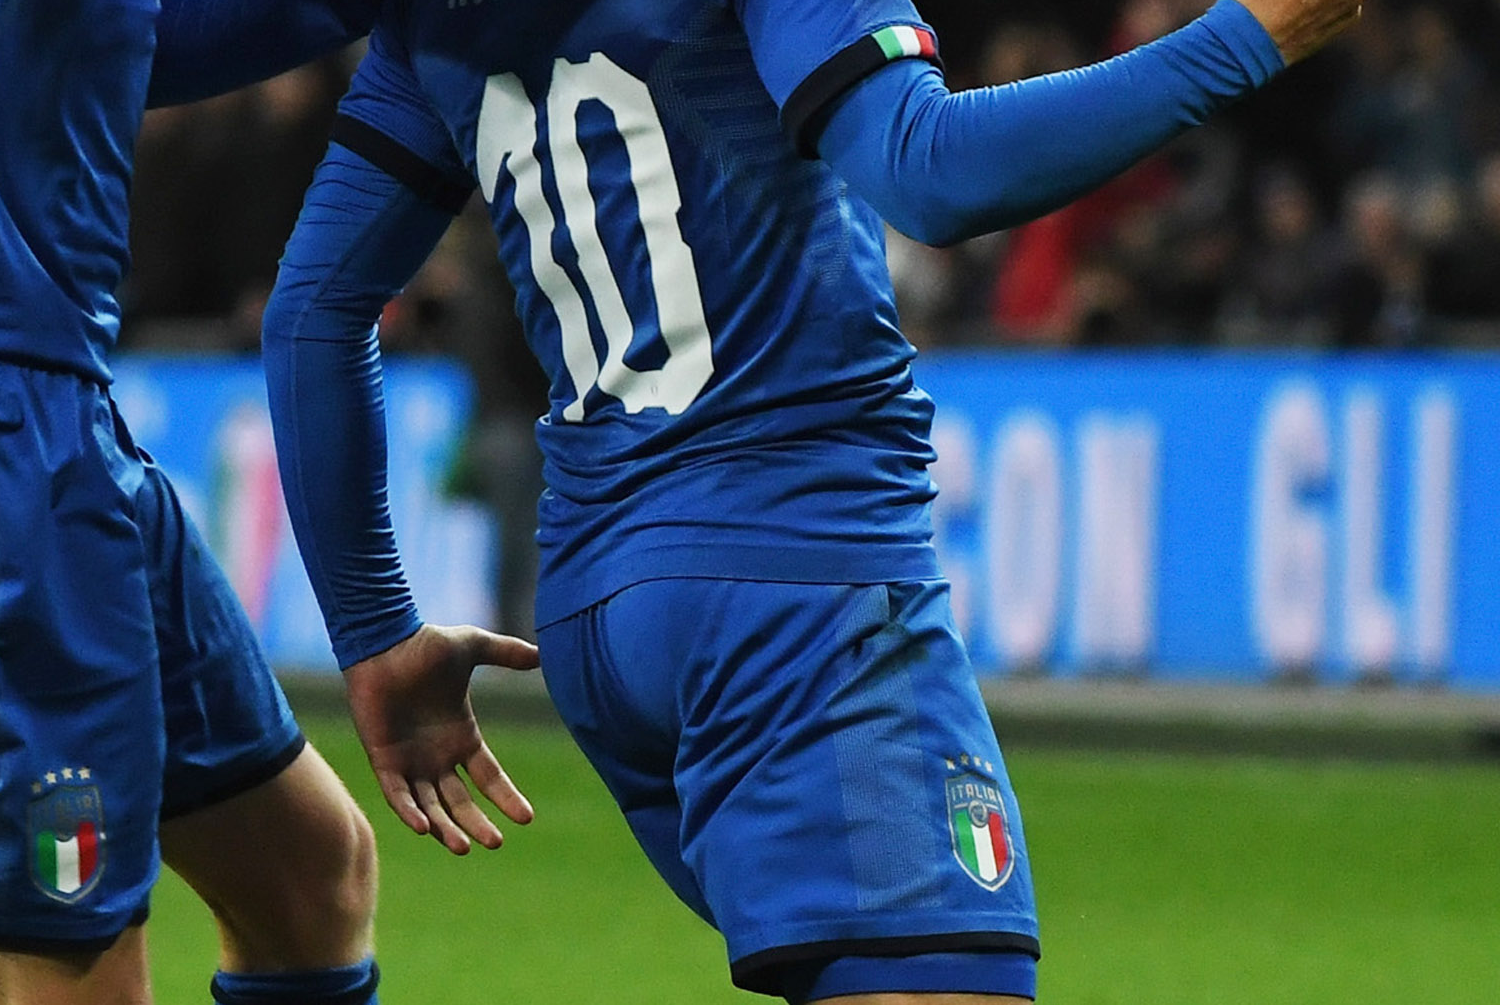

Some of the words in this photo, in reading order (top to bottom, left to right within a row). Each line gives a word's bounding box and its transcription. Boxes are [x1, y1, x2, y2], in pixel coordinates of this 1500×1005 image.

[476, 51, 715, 422] 10
[1250, 377, 1453, 671] GLI
[950, 783, 998, 802] ITALIA
